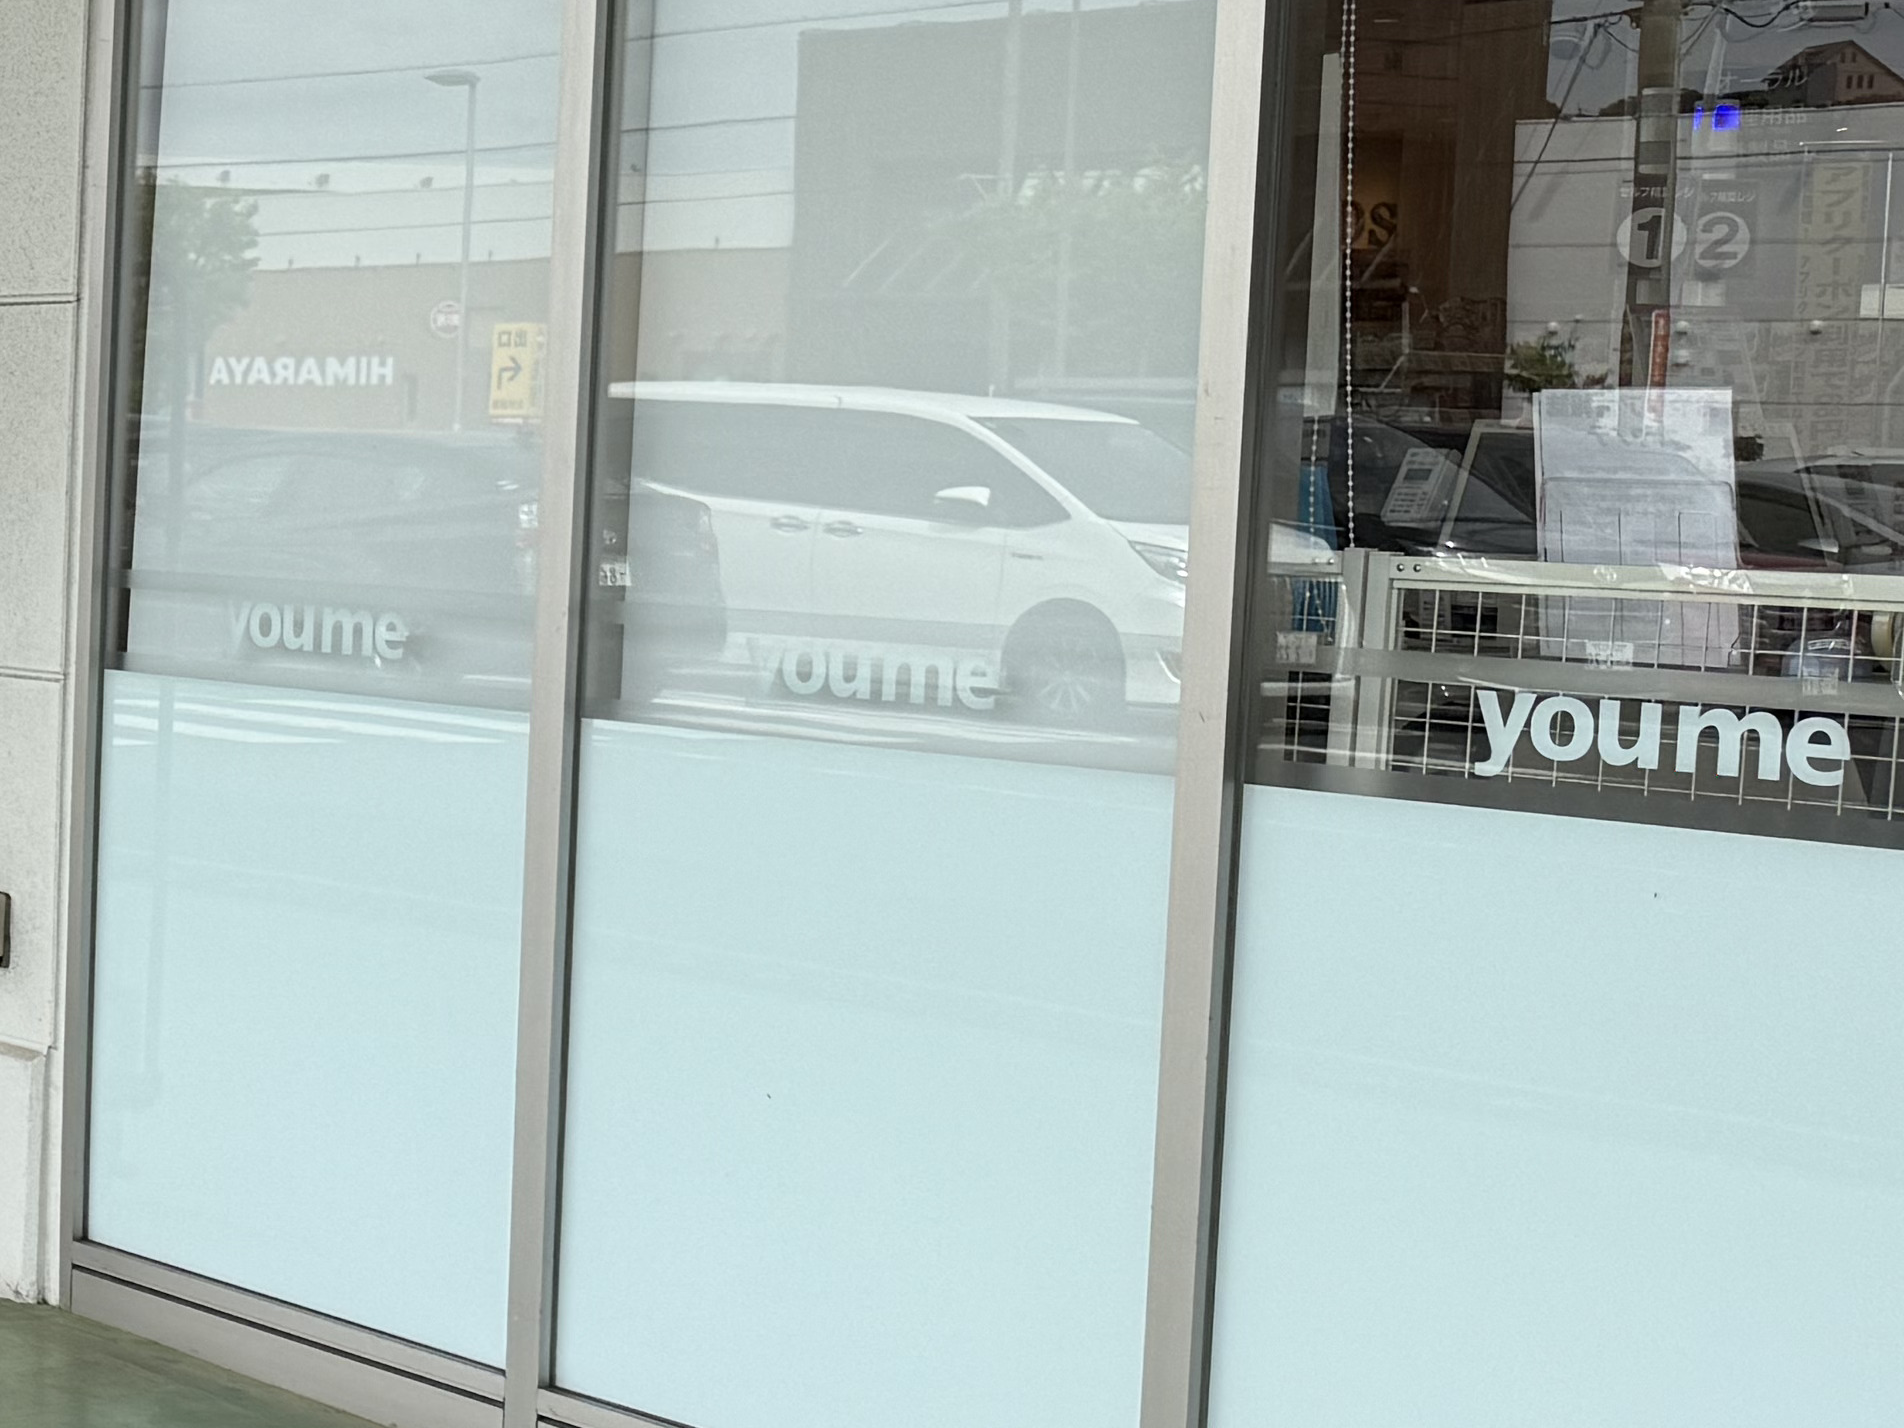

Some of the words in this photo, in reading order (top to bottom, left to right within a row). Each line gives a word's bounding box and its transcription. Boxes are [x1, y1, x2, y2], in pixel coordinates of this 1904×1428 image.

[1698, 216, 1740, 261] 2
[224, 596, 415, 662] youme
[748, 636, 1004, 716] youme
[1473, 688, 1852, 788] youme
